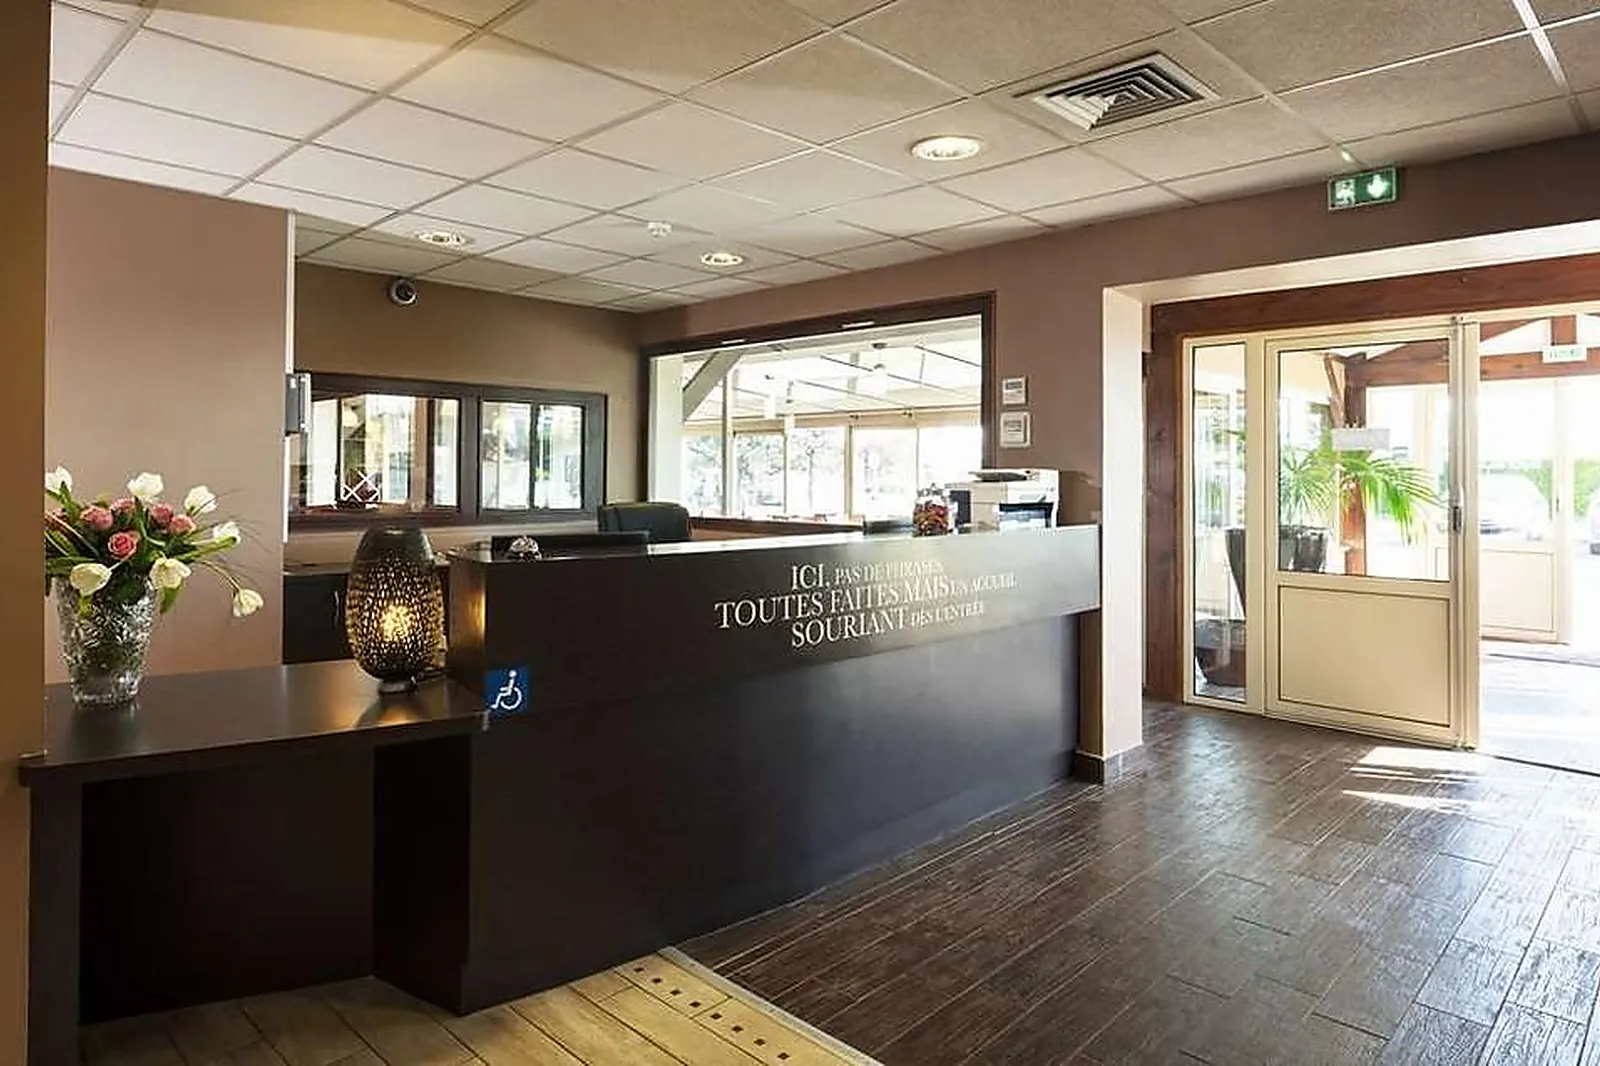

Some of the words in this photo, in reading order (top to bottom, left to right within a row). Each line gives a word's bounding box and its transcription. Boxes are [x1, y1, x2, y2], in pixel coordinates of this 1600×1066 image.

[713, 592, 824, 629] TOUTES
[830, 583, 900, 613] FAITES
[902, 574, 949, 603] MAIS
[791, 607, 909, 648] SOURIANT
